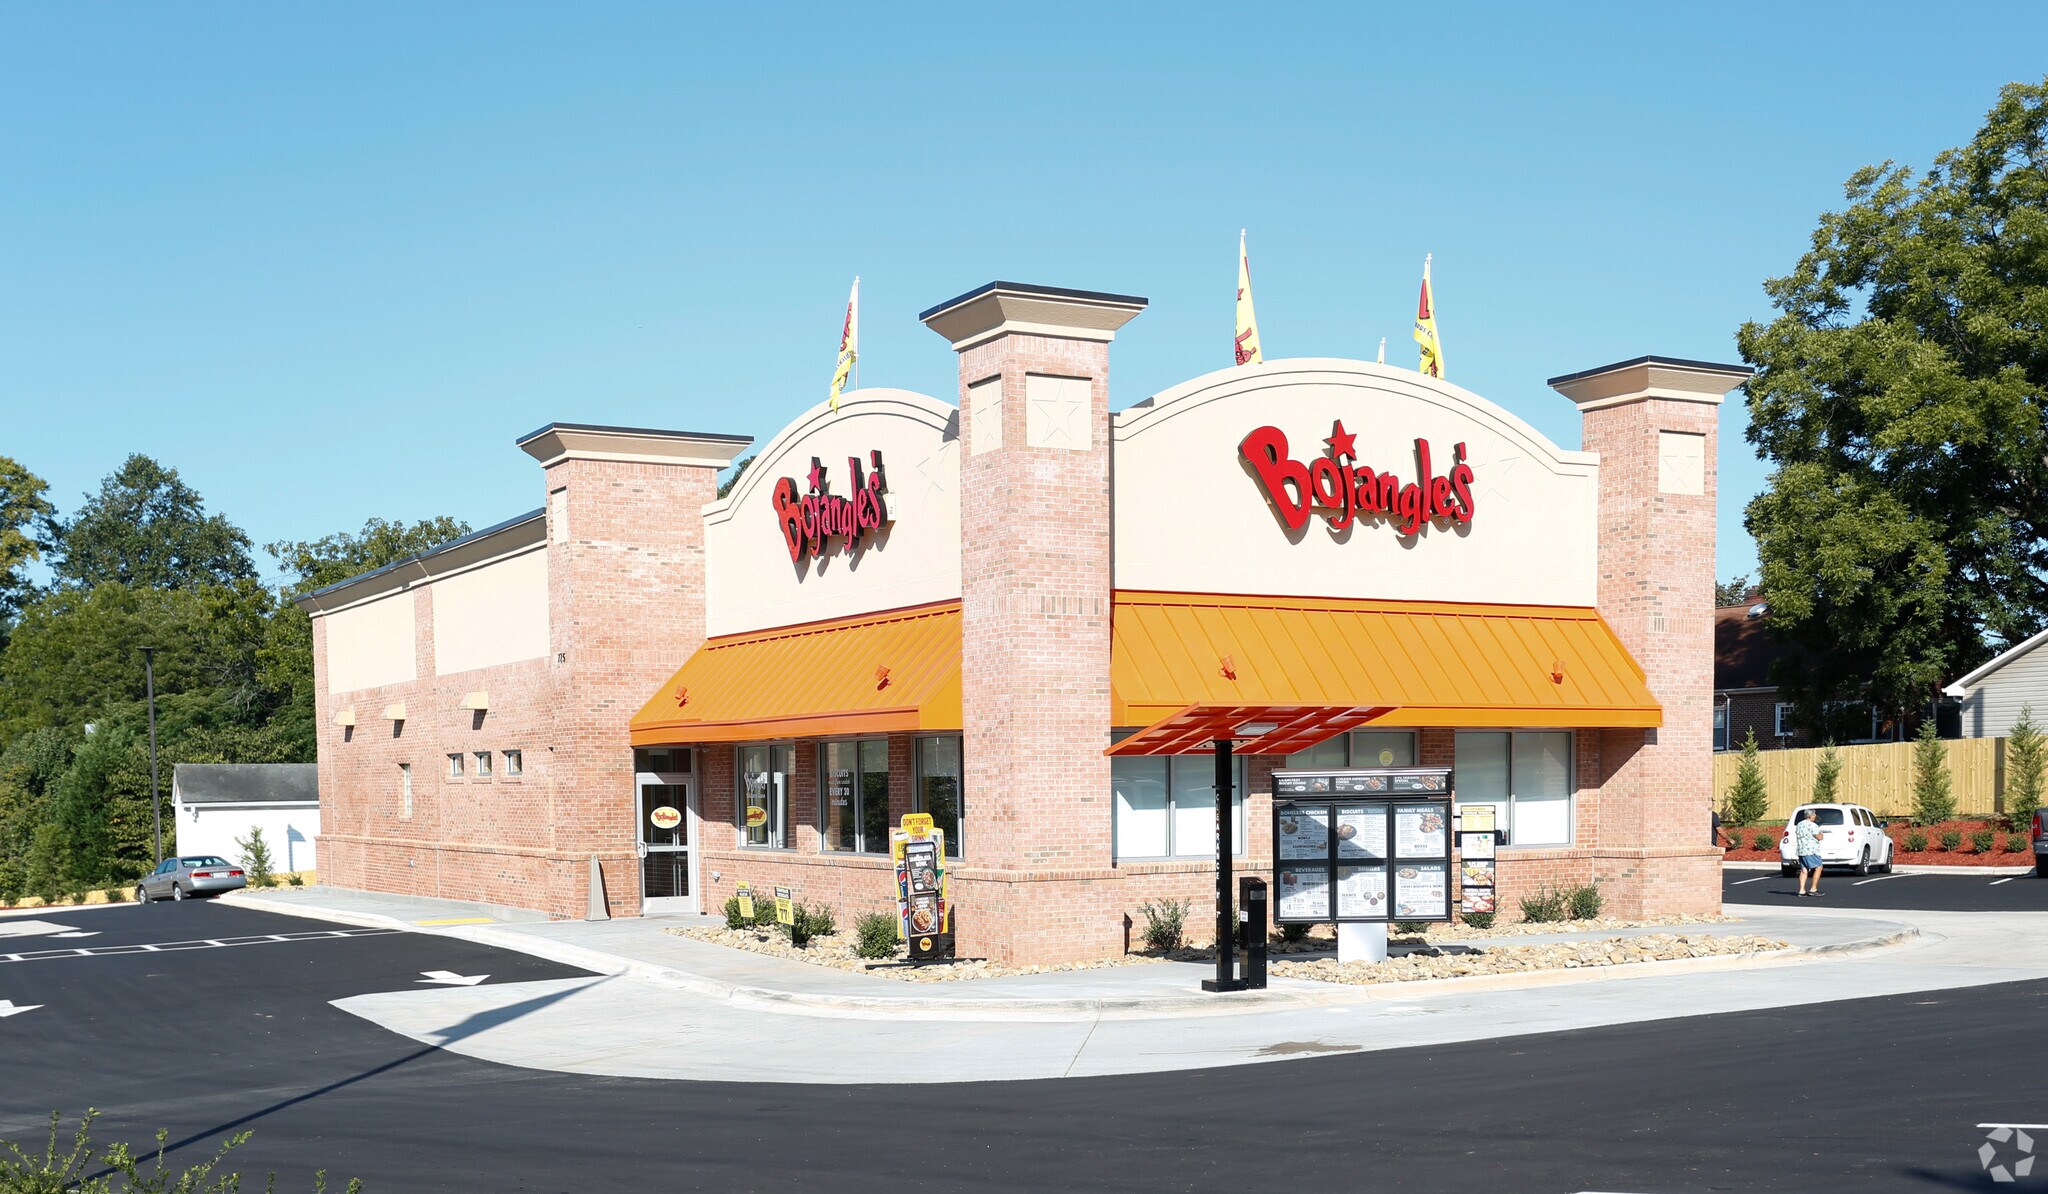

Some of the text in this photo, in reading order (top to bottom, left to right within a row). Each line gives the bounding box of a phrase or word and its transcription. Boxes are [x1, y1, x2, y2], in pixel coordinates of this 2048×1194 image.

[829, 787, 843, 796] EVERY
[903, 817, 931, 826] DON'T FORGET
[912, 826, 924, 834] YOUR
